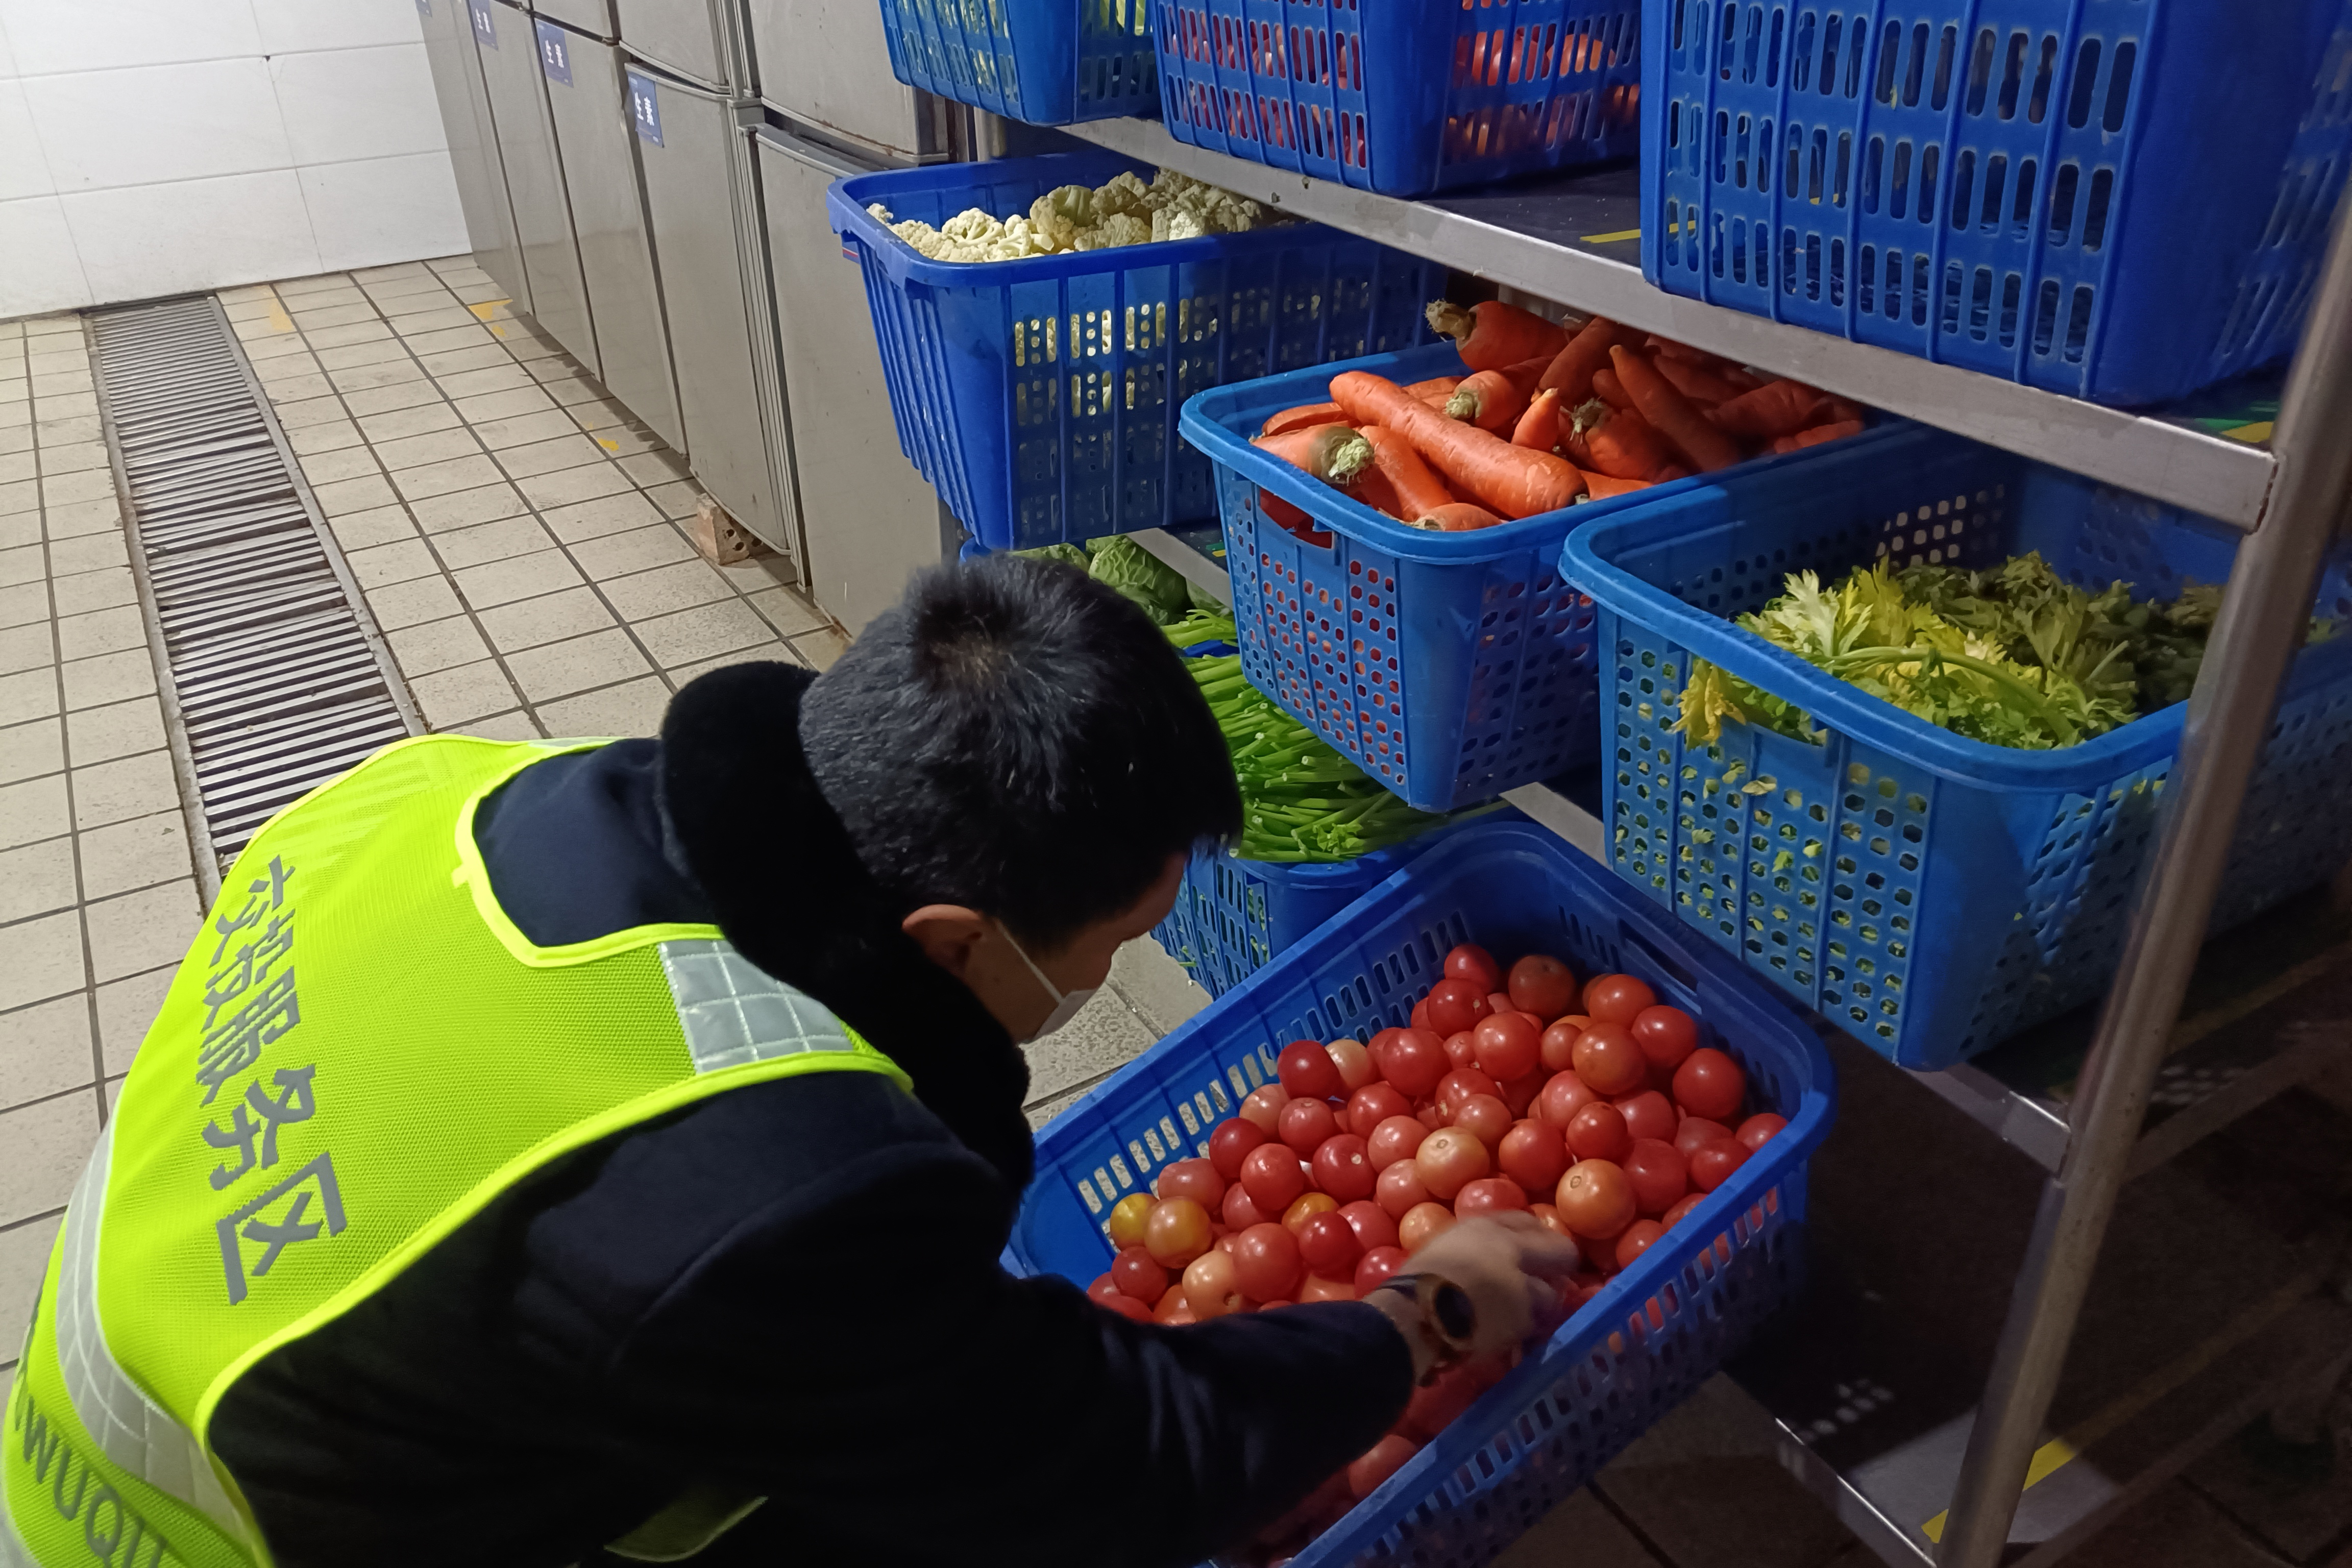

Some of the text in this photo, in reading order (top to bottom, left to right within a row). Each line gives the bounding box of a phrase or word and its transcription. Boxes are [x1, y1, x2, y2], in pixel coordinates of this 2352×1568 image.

[196, 854, 347, 1306] 交投服务区
